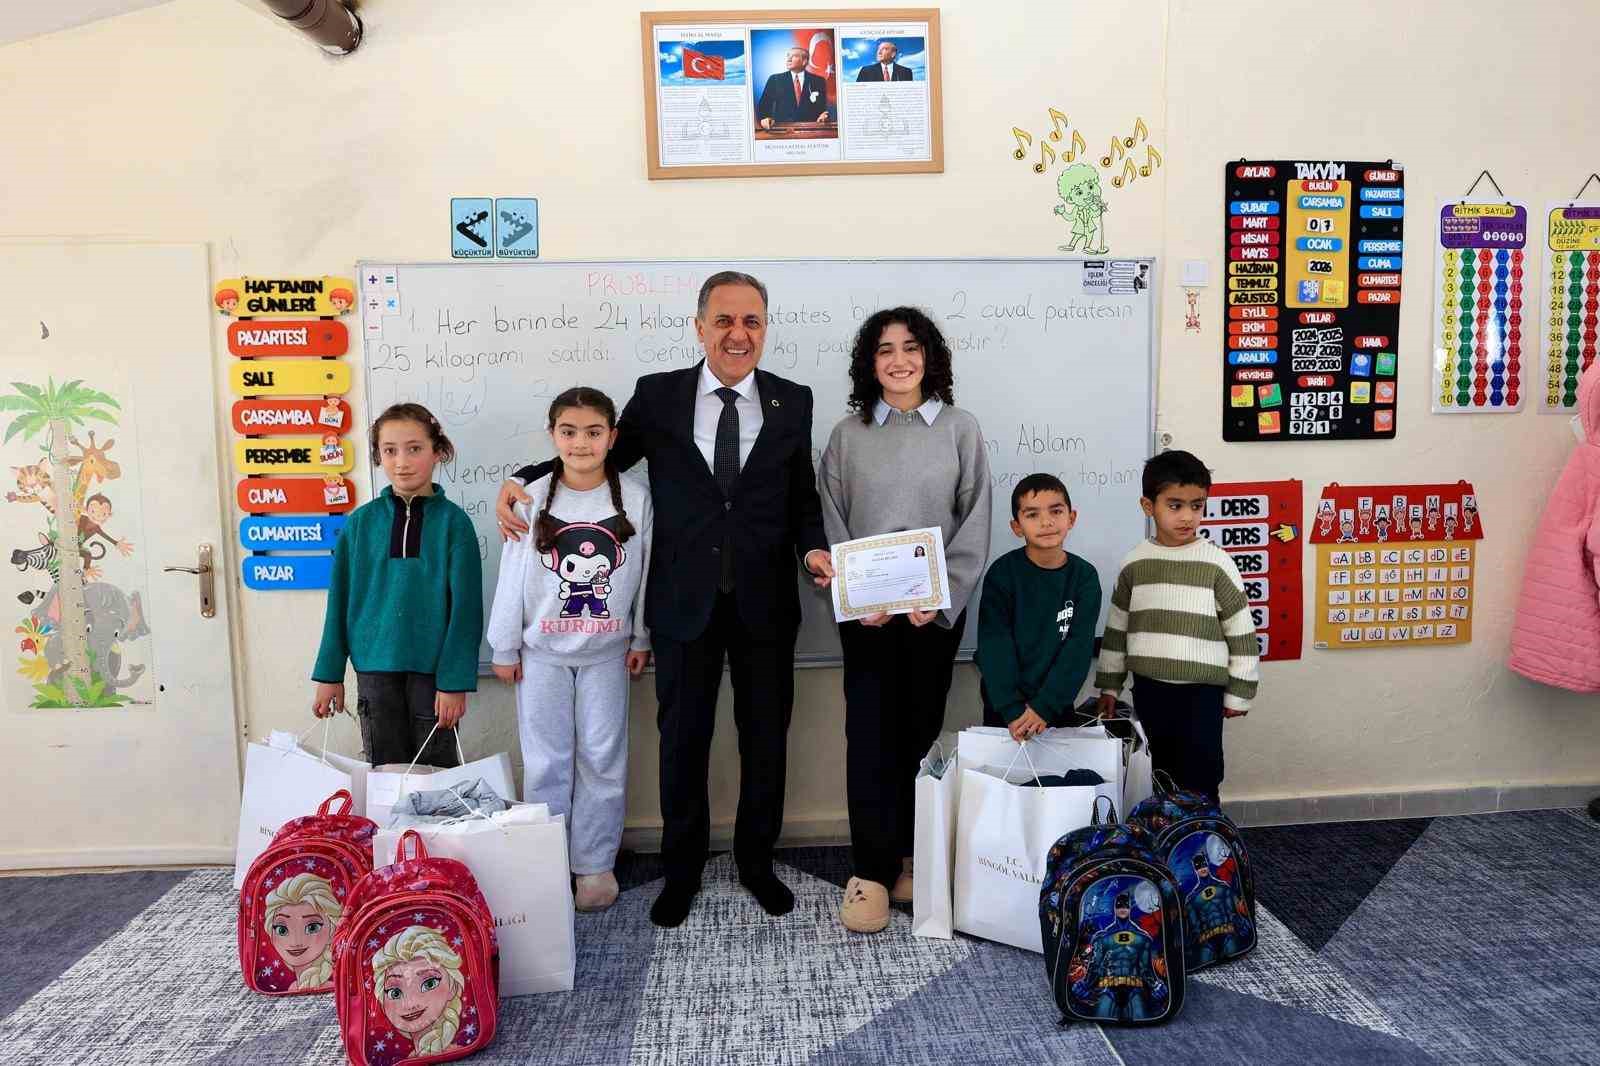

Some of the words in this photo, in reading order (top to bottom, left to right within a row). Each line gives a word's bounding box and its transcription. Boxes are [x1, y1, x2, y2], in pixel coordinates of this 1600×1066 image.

[1244, 166, 1270, 178] AYLAR
[1243, 216, 1268, 229] MART
[1306, 238, 1332, 250] OCAK
[1242, 248, 1269, 260] MAYIS
[1368, 258, 1392, 270] CUMA
[245, 280, 323, 294] HAFTANIN
[1368, 292, 1392, 303] PAZAR
[438, 308, 480, 336] Her
[494, 304, 579, 334] birinde
[594, 300, 628, 332] 24
[767, 304, 832, 325] atates
[946, 290, 968, 320] 2
[237, 328, 308, 346] PAZARTESİ
[372, 344, 411, 372] 25
[774, 332, 798, 369] kg
[242, 371, 274, 387] SALI
[1296, 394, 1300, 404] 1
[1308, 394, 1314, 404] 2
[1321, 394, 1328, 404] 3
[1332, 393, 1340, 404] 4
[241, 409, 314, 428] ÇARŞAMBA
[1294, 408, 1302, 419] 5
[1306, 408, 1314, 419] 6
[1332, 408, 1340, 418] 8
[1293, 422, 1300, 433] 9
[1307, 422, 1314, 433] 2
[1320, 422, 1326, 432] 1
[1016, 423, 1086, 456] Ablam
[246, 448, 312, 466] PERŞEMBE
[248, 488, 287, 504] CUMA
[1221, 498, 1260, 517] DERS
[248, 522, 322, 542] CUMARTESİ
[1222, 527, 1260, 546] DERS
[1231, 554, 1262, 572] ERS
[254, 566, 294, 582] PAZAR
[1118, 934, 1130, 942] B
